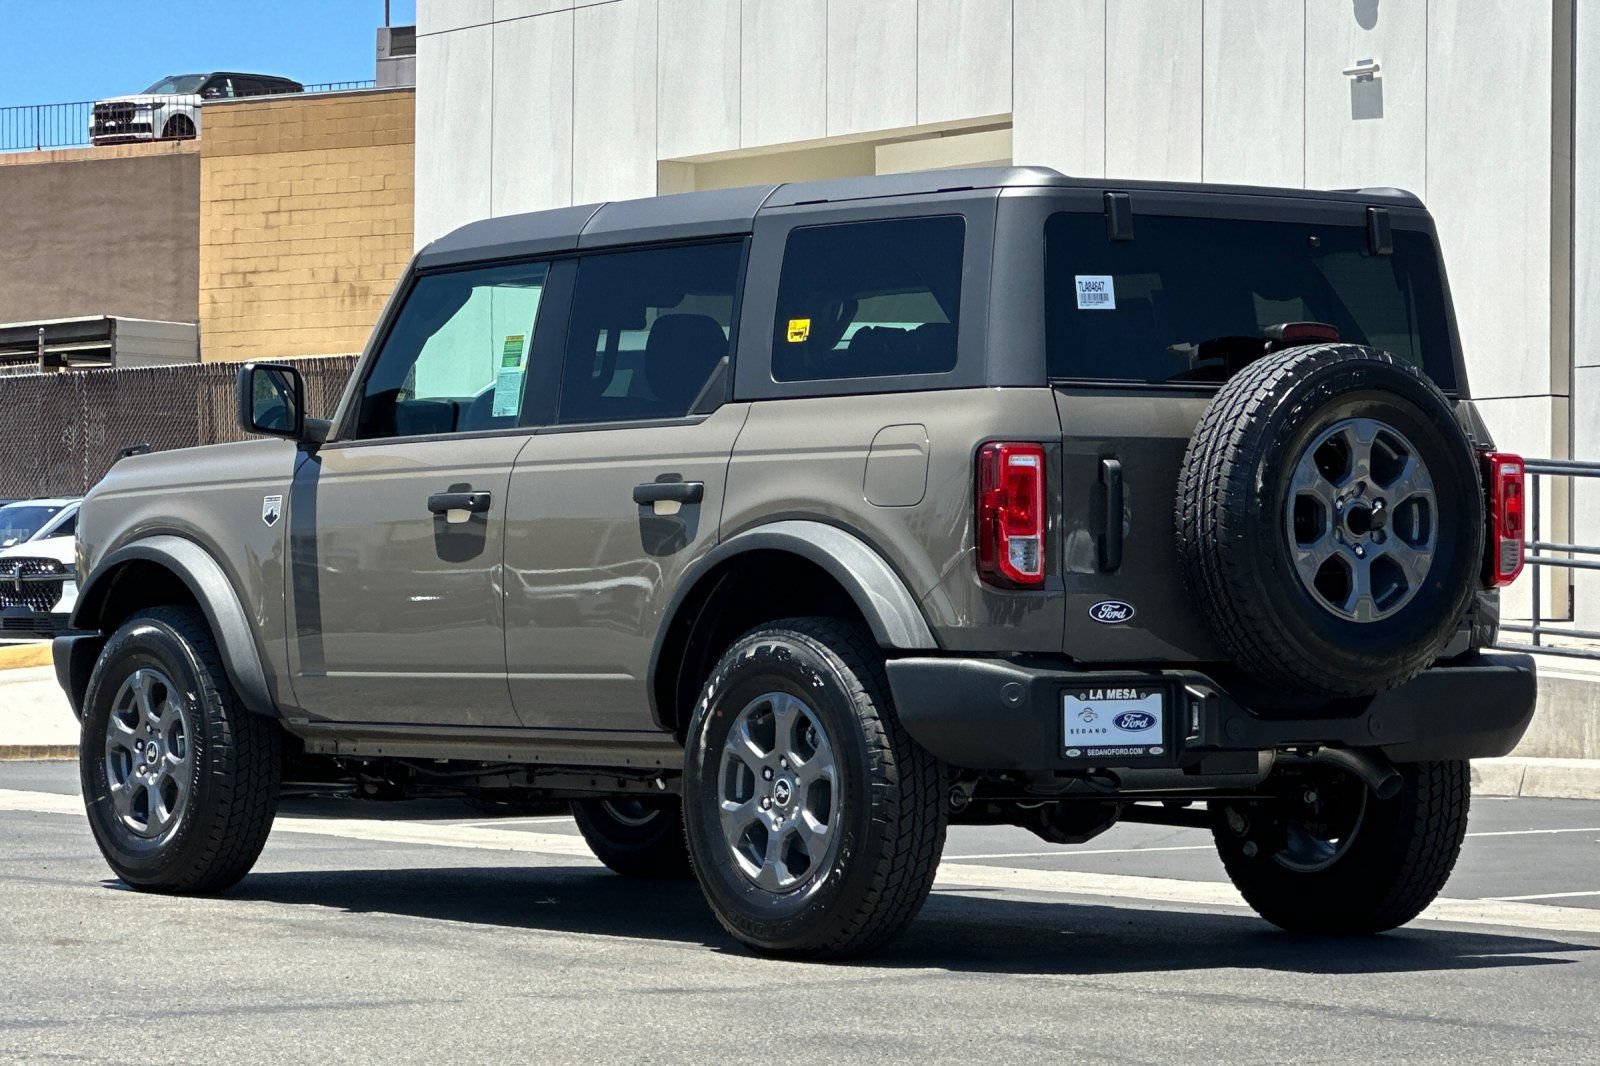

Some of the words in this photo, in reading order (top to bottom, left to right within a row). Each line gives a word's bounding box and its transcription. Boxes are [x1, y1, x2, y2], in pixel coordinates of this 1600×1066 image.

[1078, 281, 1105, 292] TLA84647
[1097, 604, 1127, 619] Ford
[1089, 689, 1104, 700] LA
[1106, 688, 1137, 699] MESA
[1121, 713, 1149, 728] Ford
[1087, 747, 1144, 756] SEDANOFORD.COM
